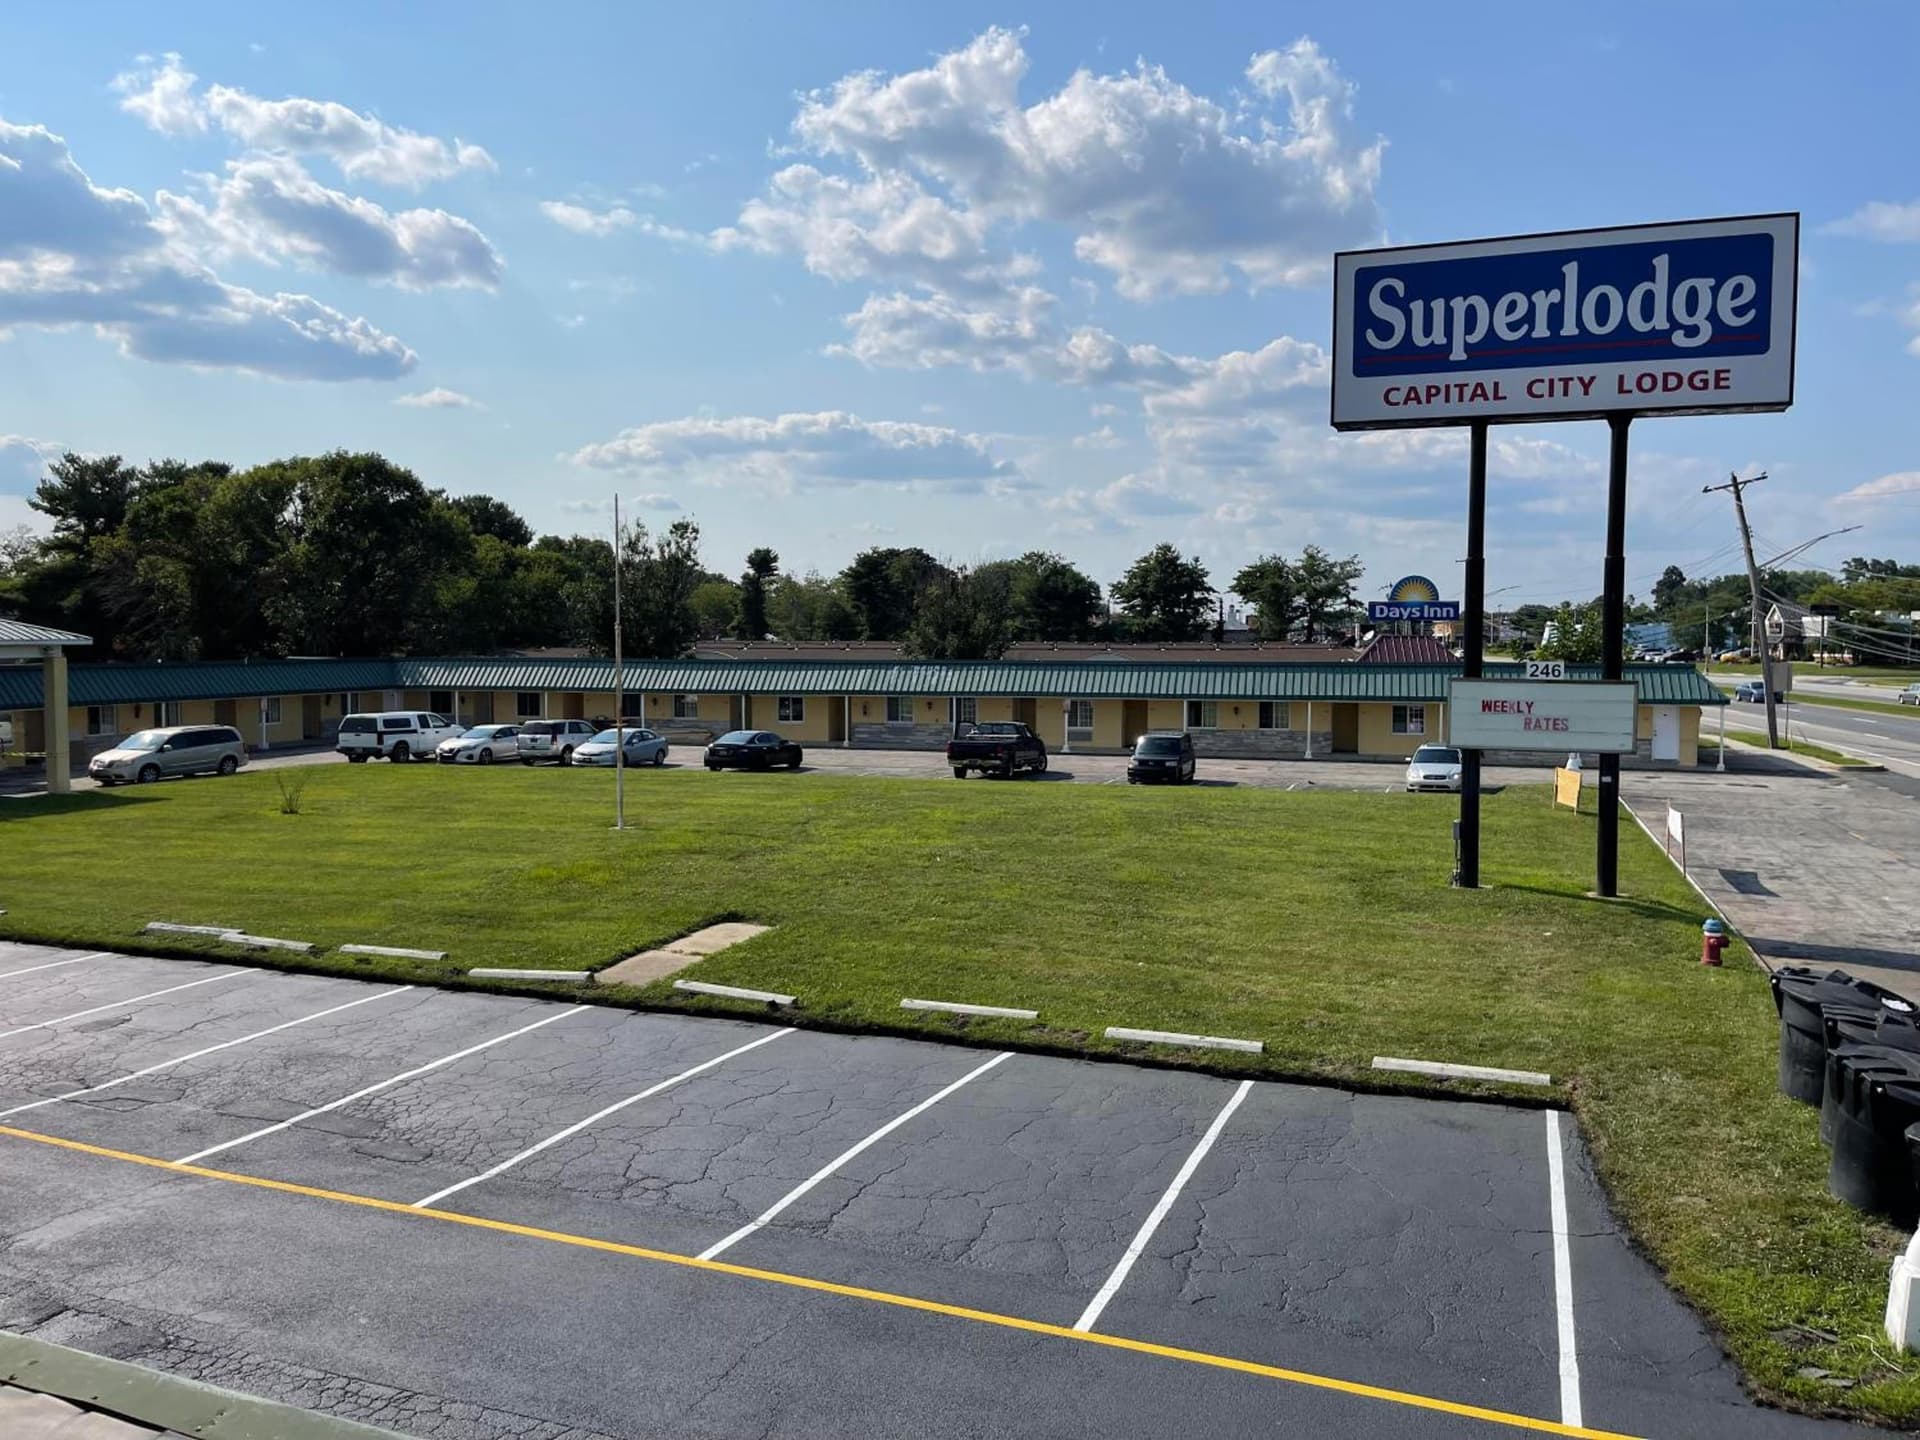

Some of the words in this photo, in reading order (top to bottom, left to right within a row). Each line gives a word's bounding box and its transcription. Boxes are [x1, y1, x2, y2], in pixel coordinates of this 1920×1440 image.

[1365, 253, 1757, 361] Superlodge
[1383, 381, 1507, 406] CAPITAL
[1525, 375, 1597, 399] CITY
[1617, 368, 1732, 394] LODGE
[1375, 604, 1421, 620] Days
[1423, 604, 1455, 618] Inn
[1529, 663, 1562, 678] 246
[1481, 700, 1535, 713] WEEKLY
[1523, 717, 1569, 731] RATES
